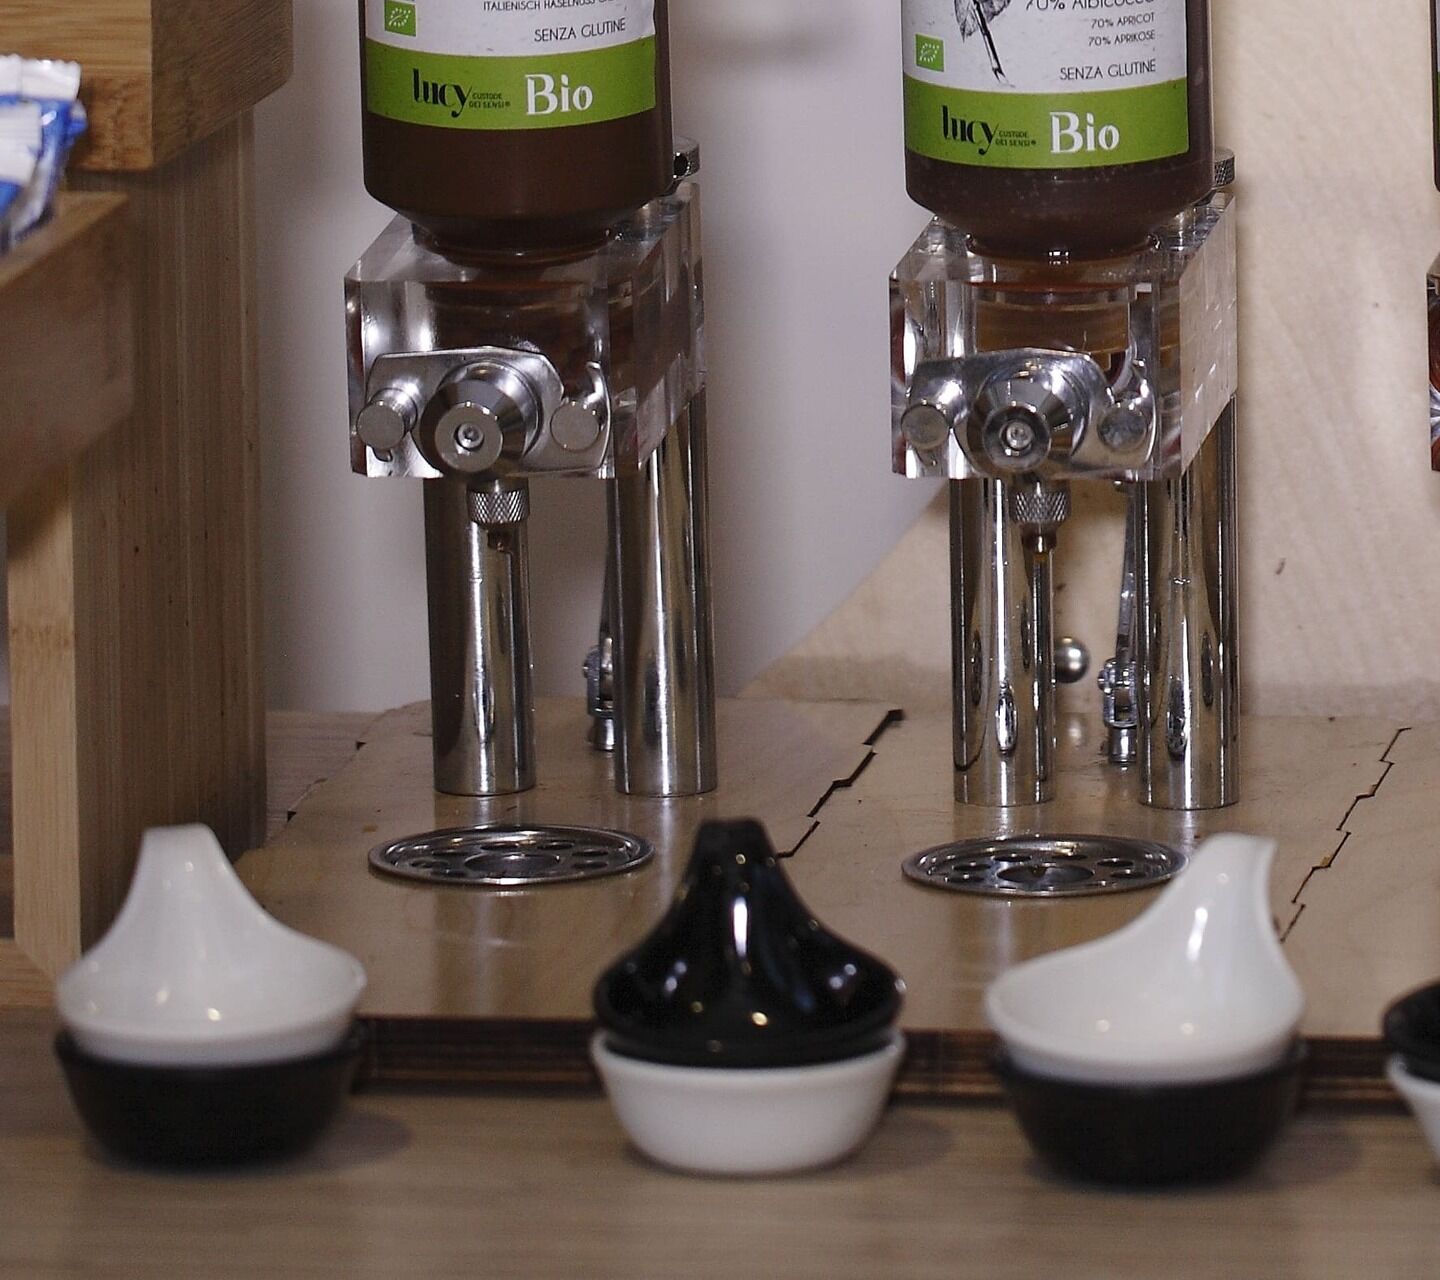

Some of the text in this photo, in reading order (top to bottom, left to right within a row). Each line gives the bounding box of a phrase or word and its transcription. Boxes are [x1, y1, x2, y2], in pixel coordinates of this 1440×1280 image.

[483, 0, 540, 11] ITALIENISCH
[534, 17, 626, 42] SENZA GLUTINE
[1091, 12, 1155, 29] 70% APRICOT
[1088, 29, 1155, 46] 70% APRIKOSE
[1060, 59, 1156, 81] SENZA GLUTINE
[412, 68, 593, 118] lucy Bio
[942, 104, 1120, 155] lucy Bio
